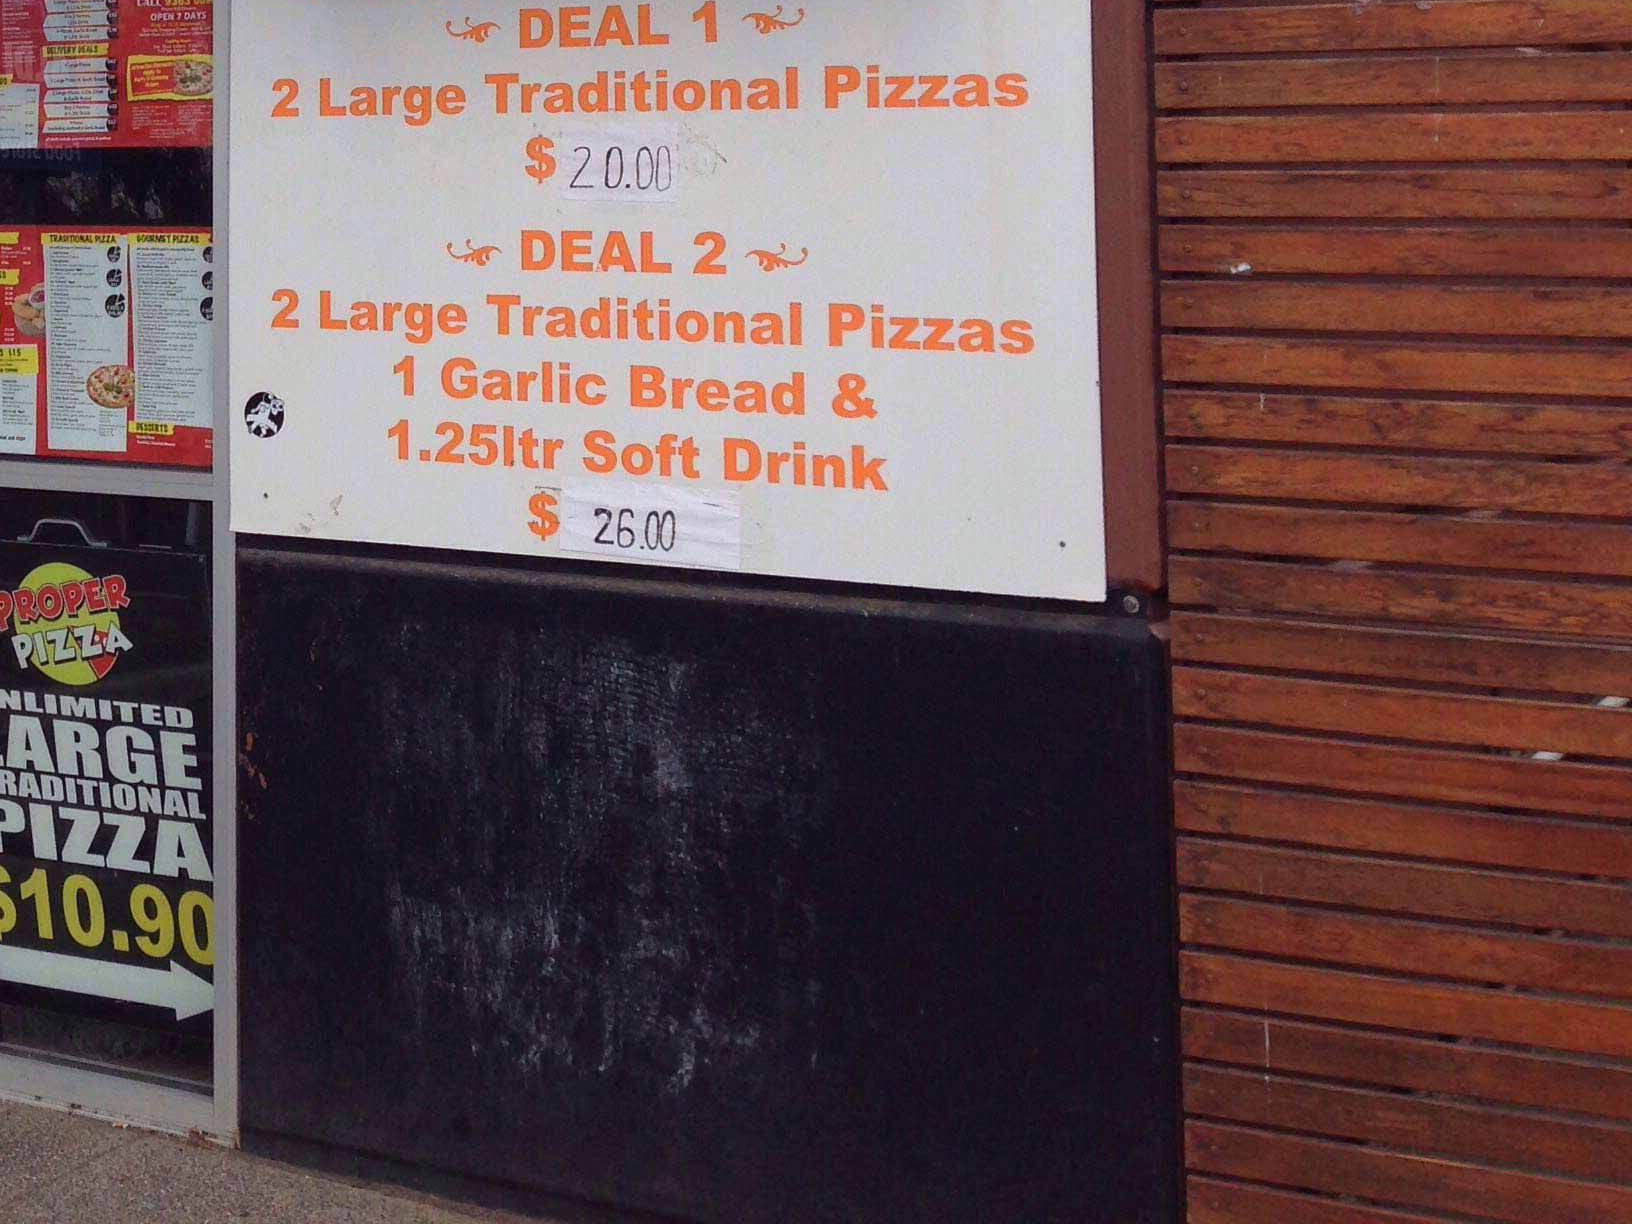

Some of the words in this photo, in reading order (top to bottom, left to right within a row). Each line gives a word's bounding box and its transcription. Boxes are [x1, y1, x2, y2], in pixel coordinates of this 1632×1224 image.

[518, 3, 670, 49] DEAL
[691, 0, 718, 43] 1
[270, 78, 300, 117] 2
[318, 77, 467, 126] Large
[484, 66, 799, 115] Traditional
[823, 64, 1030, 111] Pizzas
[524, 134, 558, 184] $
[568, 144, 672, 192] 20.00
[519, 230, 673, 273] DEAL
[691, 230, 728, 275] 2
[270, 288, 300, 330] 2
[318, 289, 468, 345] Large
[485, 294, 803, 346] Traditional
[827, 302, 1035, 355] Pizzas
[392, 355, 415, 397] 1
[440, 356, 608, 406] Garlic
[629, 364, 806, 416] Bread
[831, 373, 879, 420] &
[386, 419, 564, 471] 1.25ltr
[582, 429, 700, 478] Soft
[723, 437, 889, 492] Drink
[527, 490, 560, 541] $
[593, 508, 676, 552] 26.00
[10, 620, 134, 671] PIZZA
